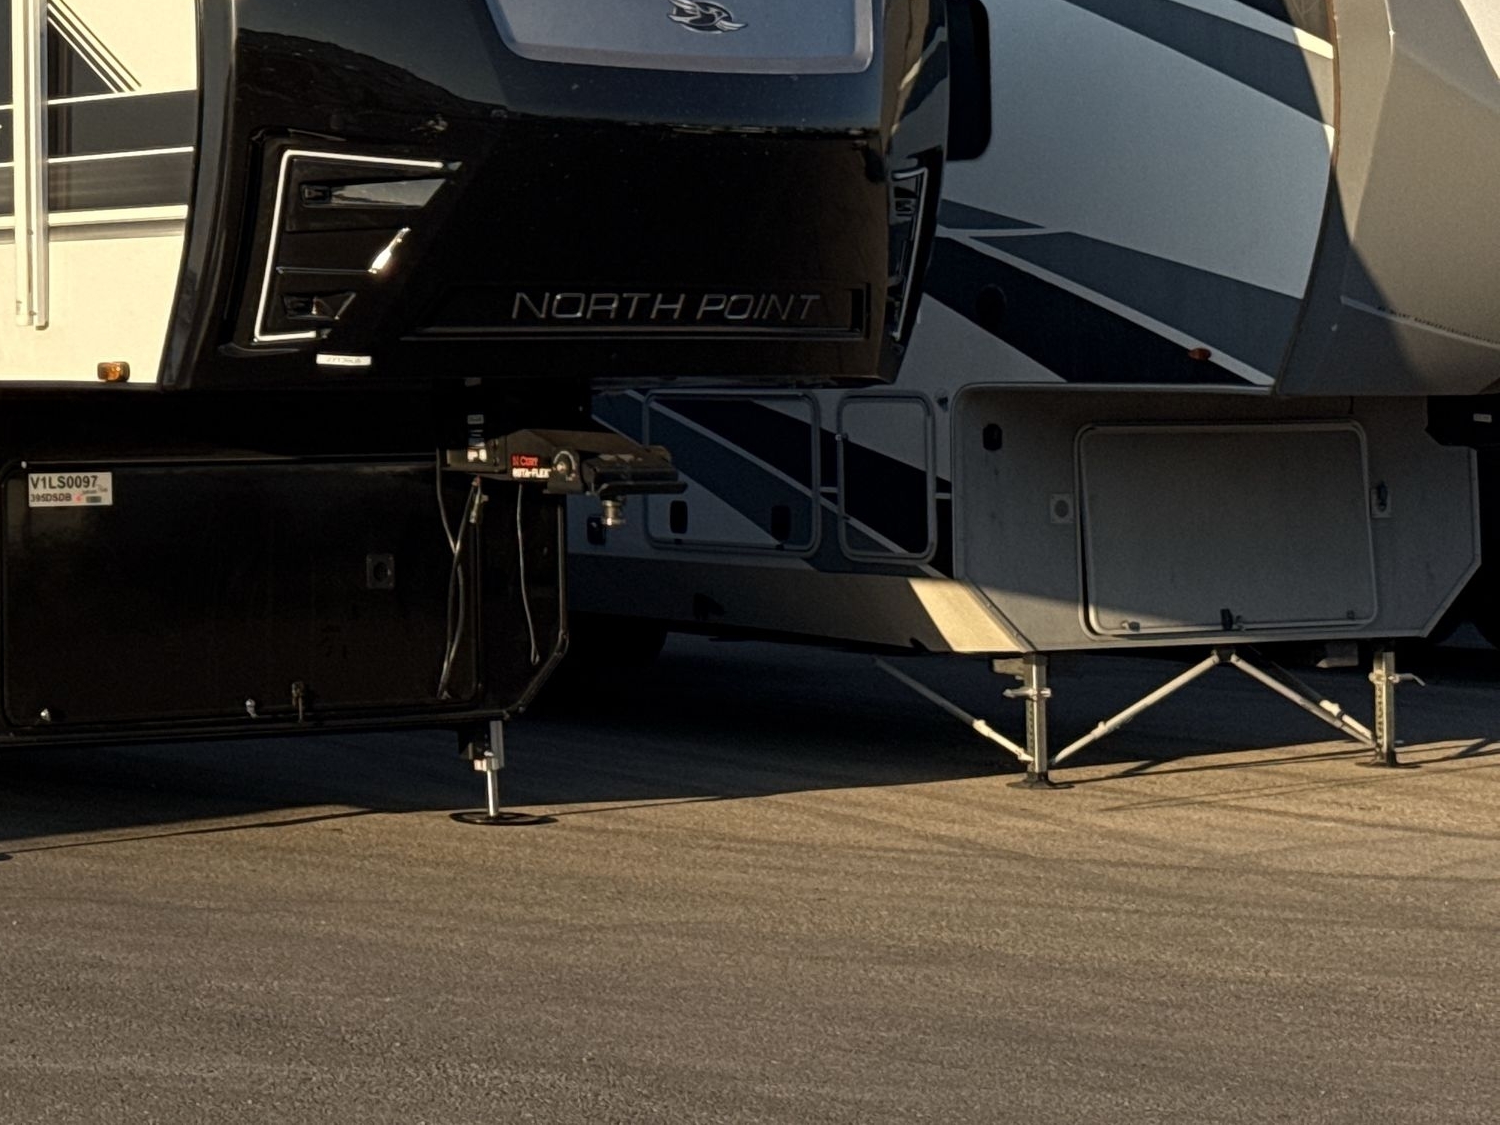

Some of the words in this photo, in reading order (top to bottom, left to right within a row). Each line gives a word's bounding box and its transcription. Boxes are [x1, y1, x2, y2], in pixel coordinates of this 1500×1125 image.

[511, 291, 686, 320] NORTH
[695, 293, 821, 320] POINT
[30, 475, 99, 490] V1LS0097
